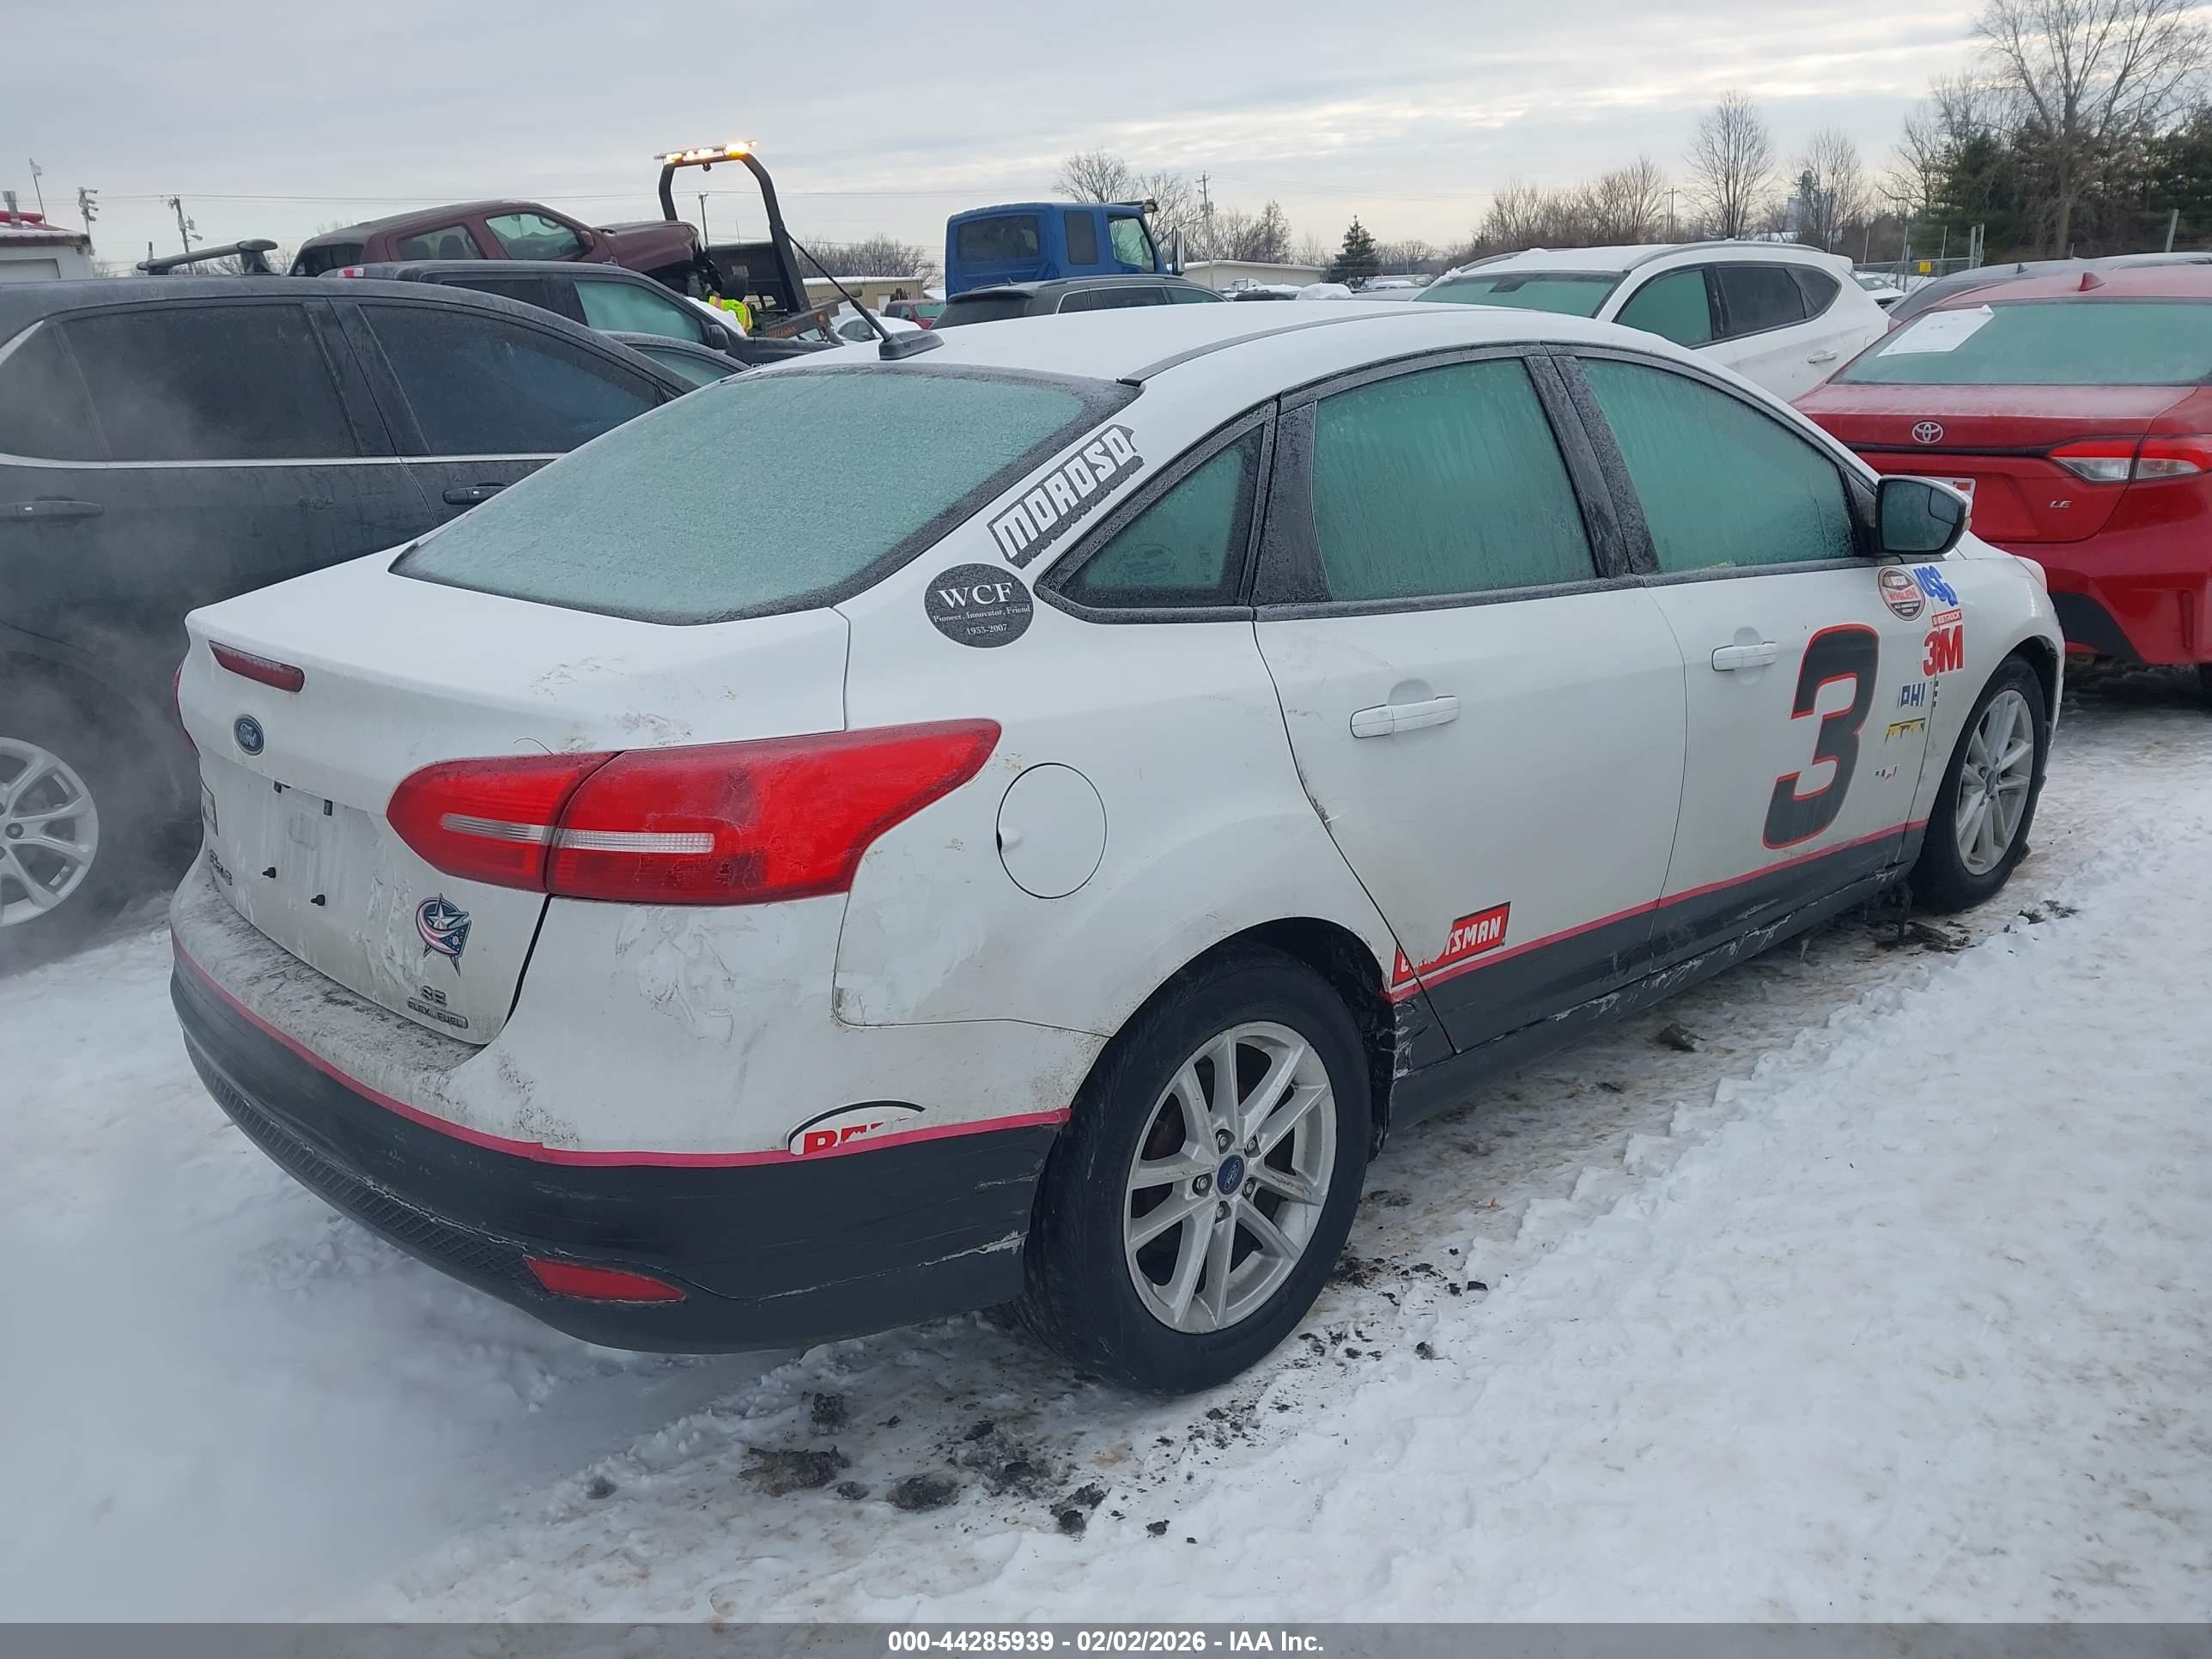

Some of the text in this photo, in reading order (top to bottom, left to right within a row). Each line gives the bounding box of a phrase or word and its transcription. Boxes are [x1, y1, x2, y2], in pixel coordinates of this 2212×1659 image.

[990, 426, 1135, 560] MOROSO
[2049, 500, 2074, 508] LE
[937, 582, 1013, 609] WCF
[1006, 605, 1031, 615] Friend
[1923, 624, 1964, 677] 3M
[1763, 623, 1881, 850] 3
[420, 985, 447, 1008] SE
